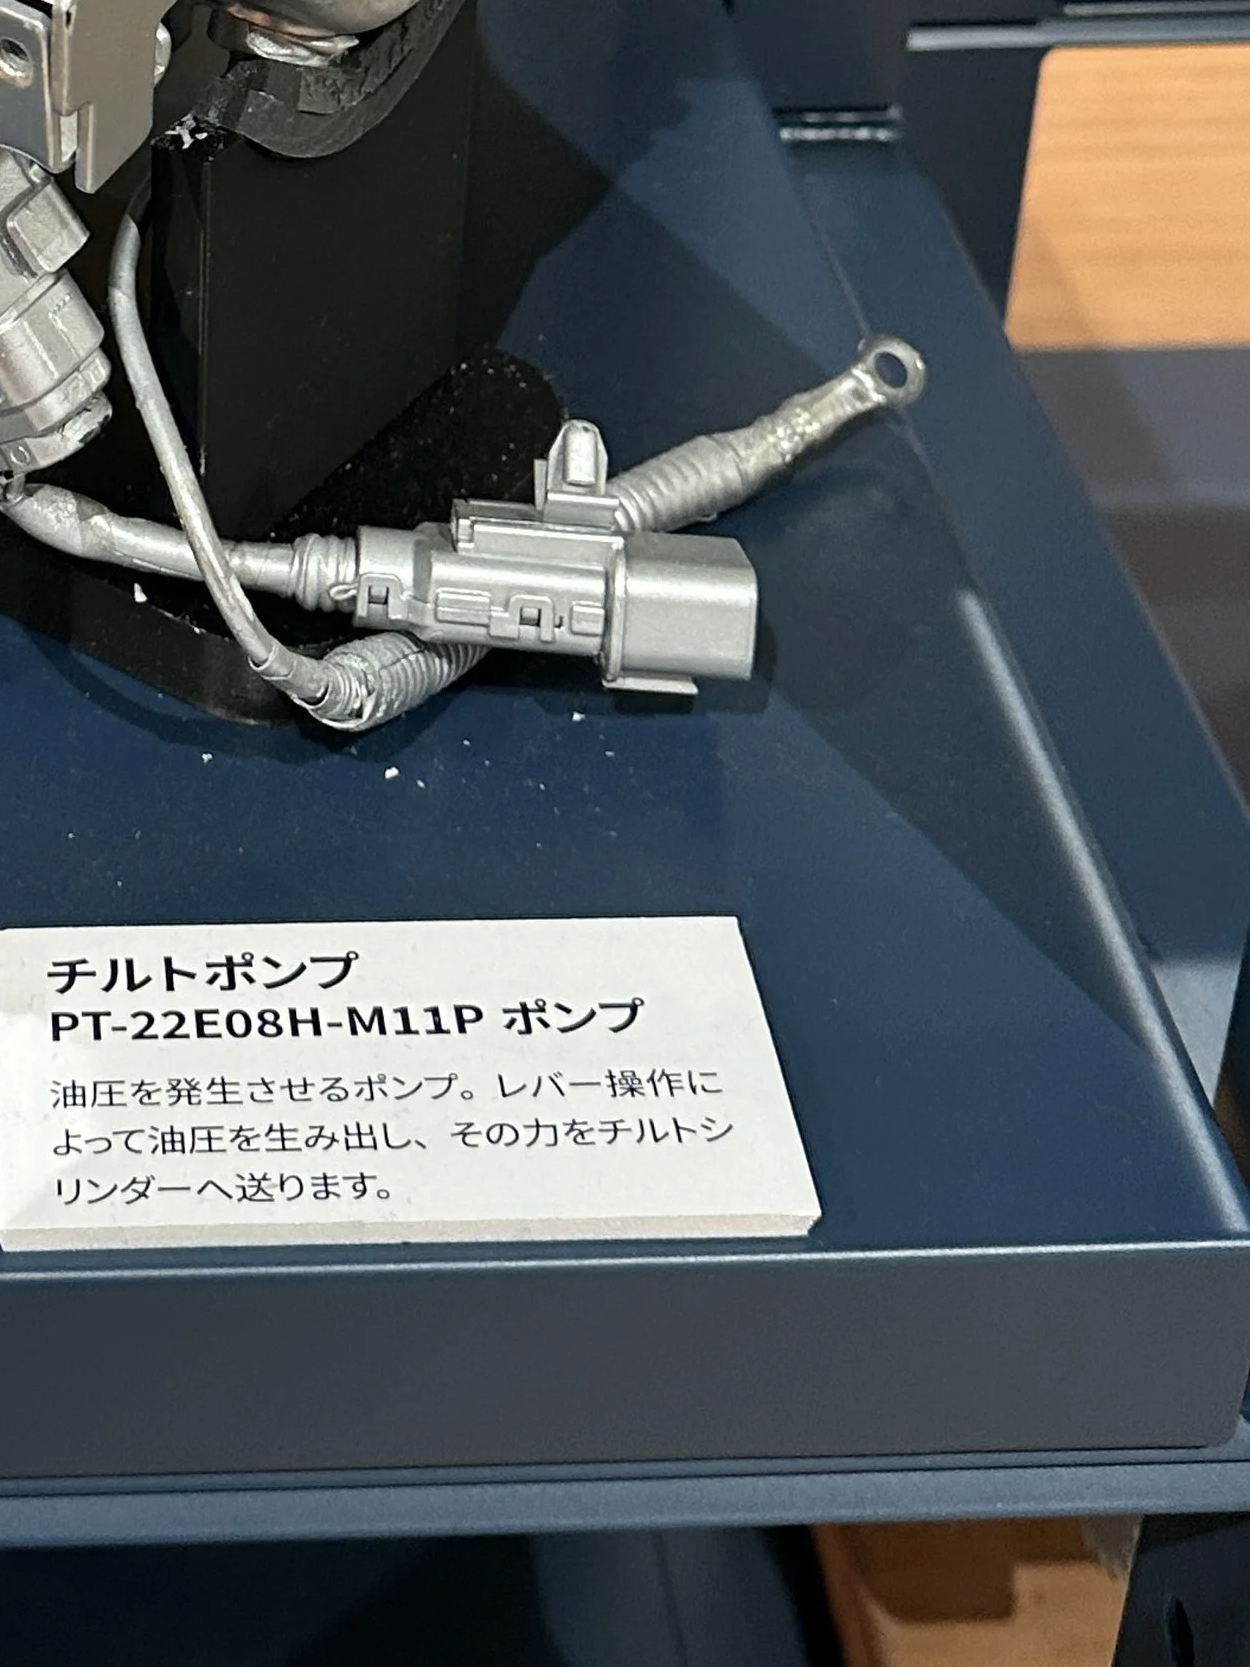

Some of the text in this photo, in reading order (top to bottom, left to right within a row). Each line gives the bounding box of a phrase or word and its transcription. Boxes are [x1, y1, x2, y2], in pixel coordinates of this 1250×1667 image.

[47, 950, 360, 994] チルトポンプ
[50, 997, 645, 1041] PT-22E08H-M11P ポンプ
[50, 1068, 723, 1109] 油圧を発生させるポンプ。レバー操作に
[53, 1116, 734, 1156] よって油圧を生み出し、その力をチルトシ
[56, 1172, 391, 1205] リンダーへ送ります。
